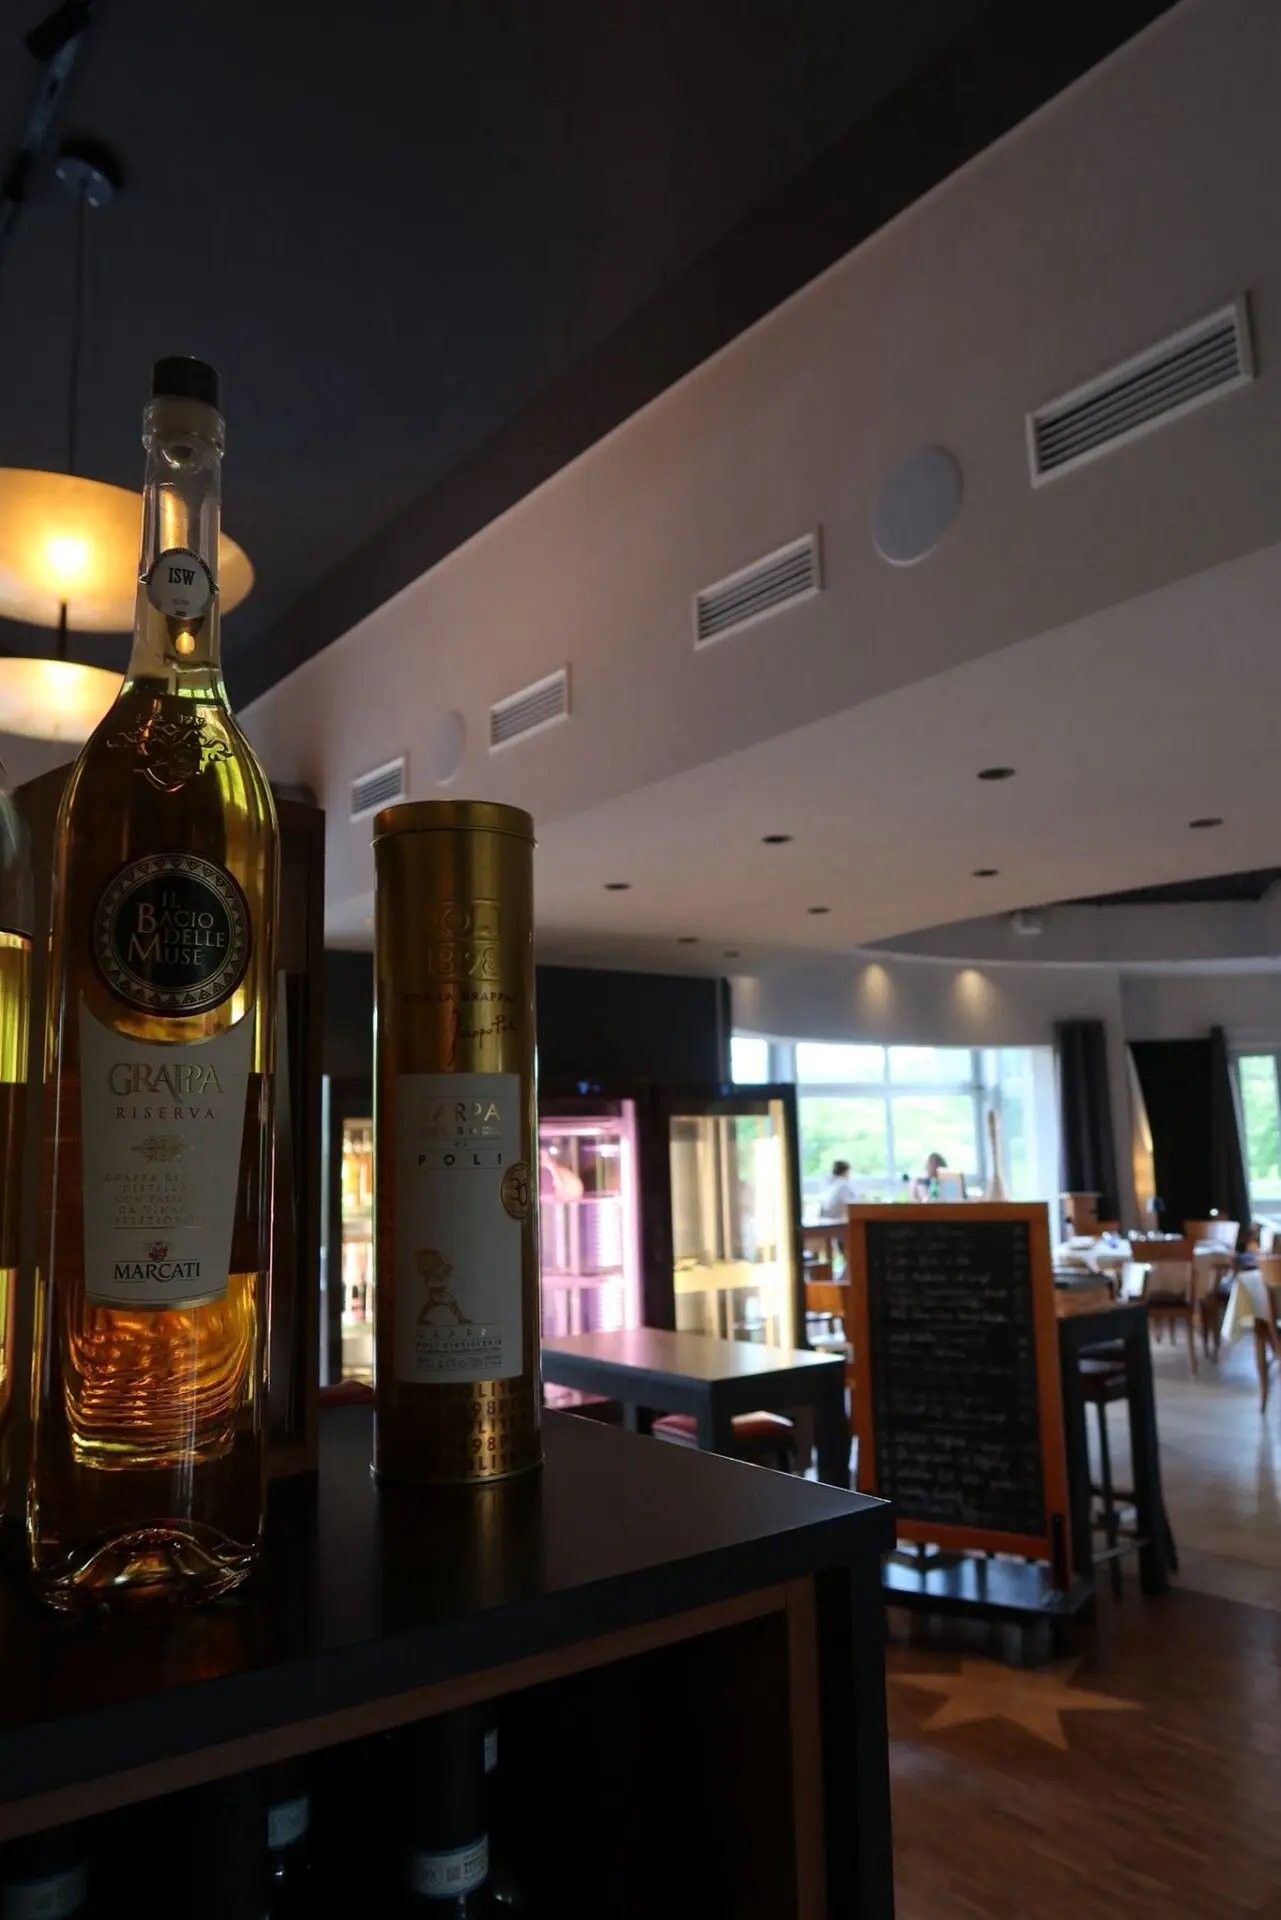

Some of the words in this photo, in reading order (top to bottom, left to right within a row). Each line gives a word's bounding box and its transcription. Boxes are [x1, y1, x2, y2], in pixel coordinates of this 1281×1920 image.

[168, 567, 197, 586] ISW
[162, 890, 181, 909] IL
[137, 902, 215, 935] BACIO
[127, 931, 203, 966] MUSE
[164, 927, 226, 949] DELLE
[107, 1062, 226, 1103] GRAPPA
[116, 1105, 215, 1121] RISERVA
[418, 1153, 502, 1167] POLI
[113, 1261, 201, 1283] MARCATI
